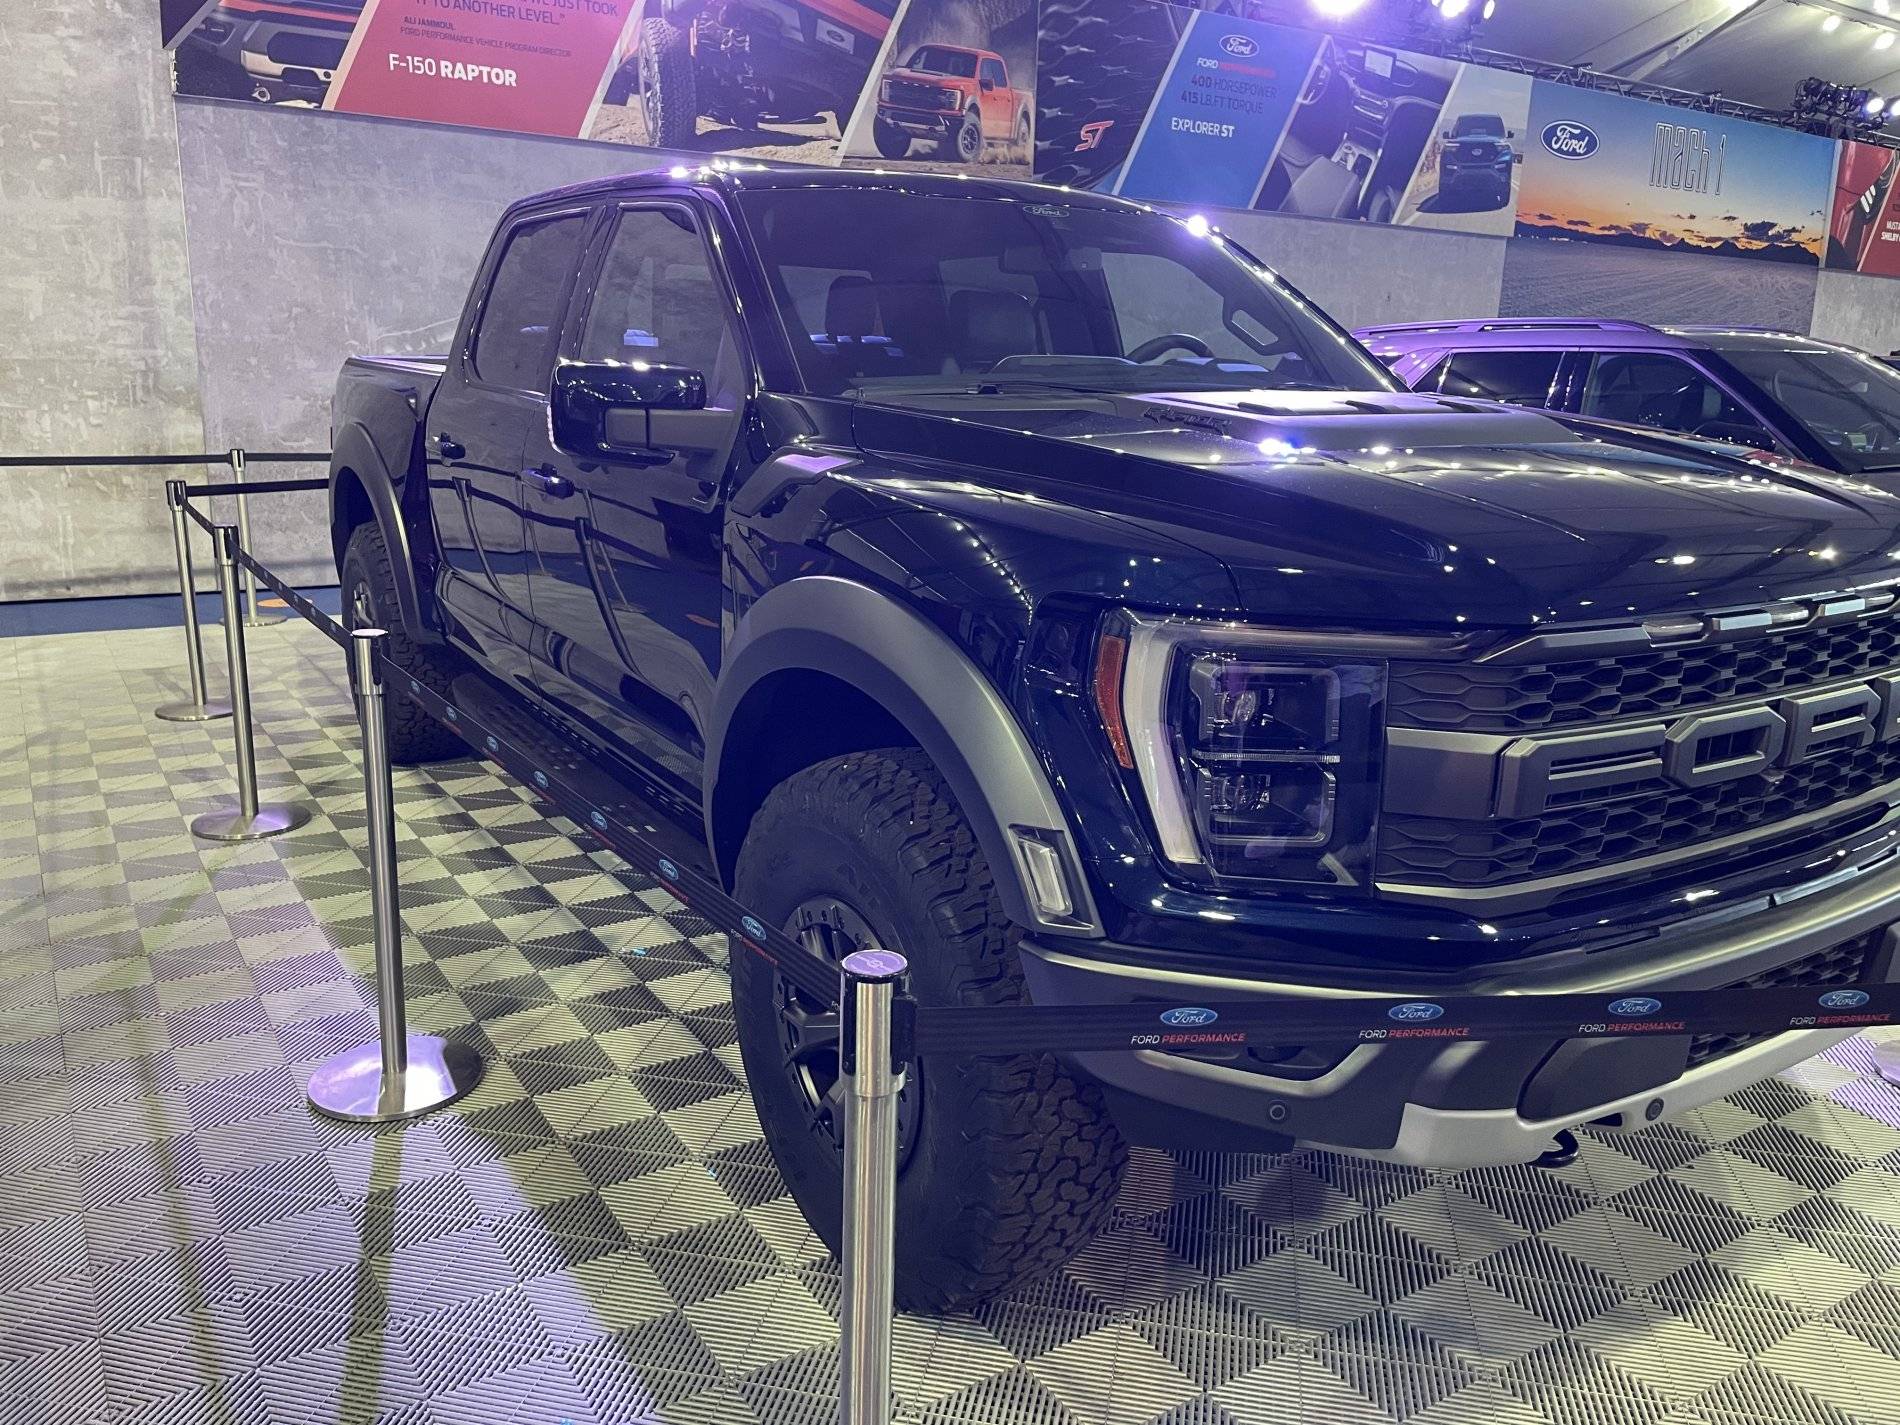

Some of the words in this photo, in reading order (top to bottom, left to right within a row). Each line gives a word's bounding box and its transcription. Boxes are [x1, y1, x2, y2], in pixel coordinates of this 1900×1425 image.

[453, 0, 515, 19] ANOTHER
[584, 0, 618, 16] TOOK
[403, 16, 416, 25] ALI
[388, 53, 436, 76] F-150
[439, 60, 517, 87] RAPTOR
[1196, 57, 1219, 69] FORD
[1191, 74, 1212, 88] 400
[1214, 78, 1278, 98] HORSEPOWER
[1181, 90, 1199, 104] 415
[1171, 117, 1220, 136] EXPLORER
[1220, 124, 1235, 138] ST
[1074, 120, 1115, 152] ST
[1499, 676, 1900, 819] FOR
[1789, 1016, 1816, 1025] FORD
[1817, 1013, 1890, 1024] PERFORMANCE
[1358, 1029, 1387, 1039] FORD
[1388, 1027, 1470, 1038] PERFORMANCE
[1578, 1023, 1606, 1033] FORD
[1606, 1021, 1686, 1032] PERFORMANCE
[1130, 1034, 1160, 1044] FORD
[1161, 1033, 1246, 1044] PERFORMANCE
